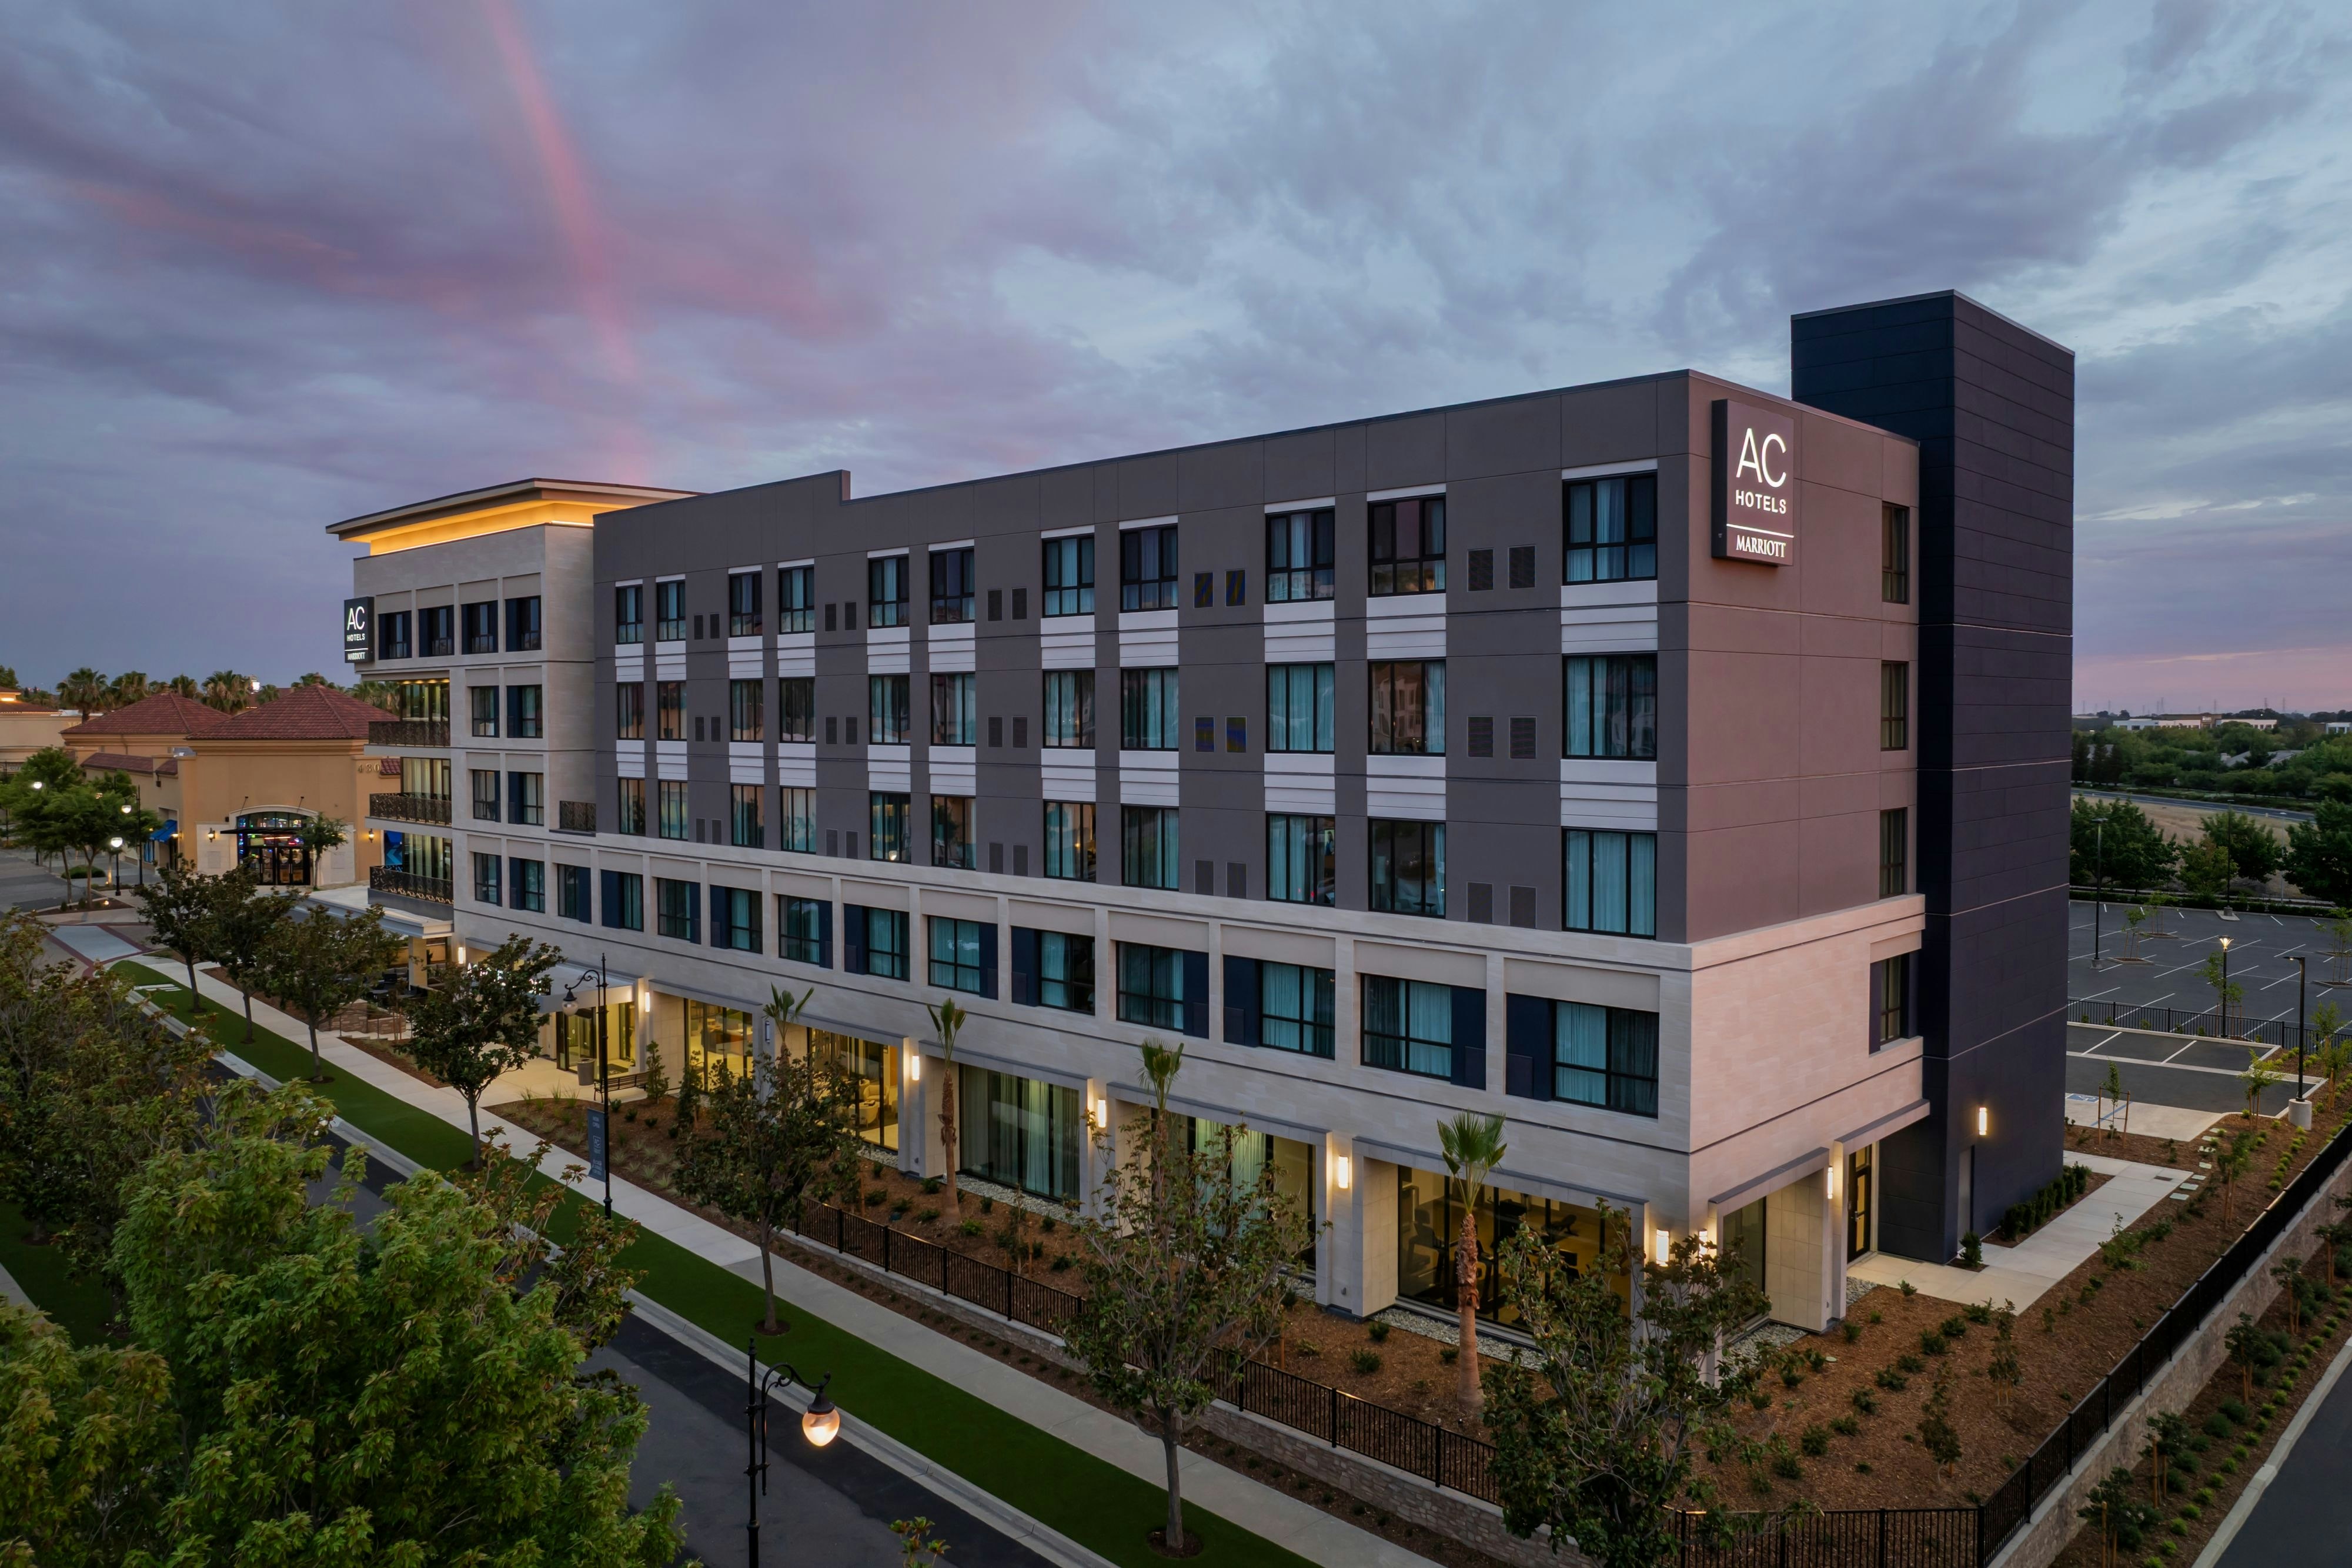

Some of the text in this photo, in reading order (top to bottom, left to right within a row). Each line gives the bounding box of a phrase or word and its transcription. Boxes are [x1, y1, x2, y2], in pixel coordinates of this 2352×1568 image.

[1736, 427, 1786, 487] AC
[1735, 489, 1786, 514] HOTELS
[1736, 534, 1786, 558] MARRIOTT
[347, 606, 365, 630] AC
[347, 633, 365, 641] HOTELS
[358, 763, 380, 773] 430
